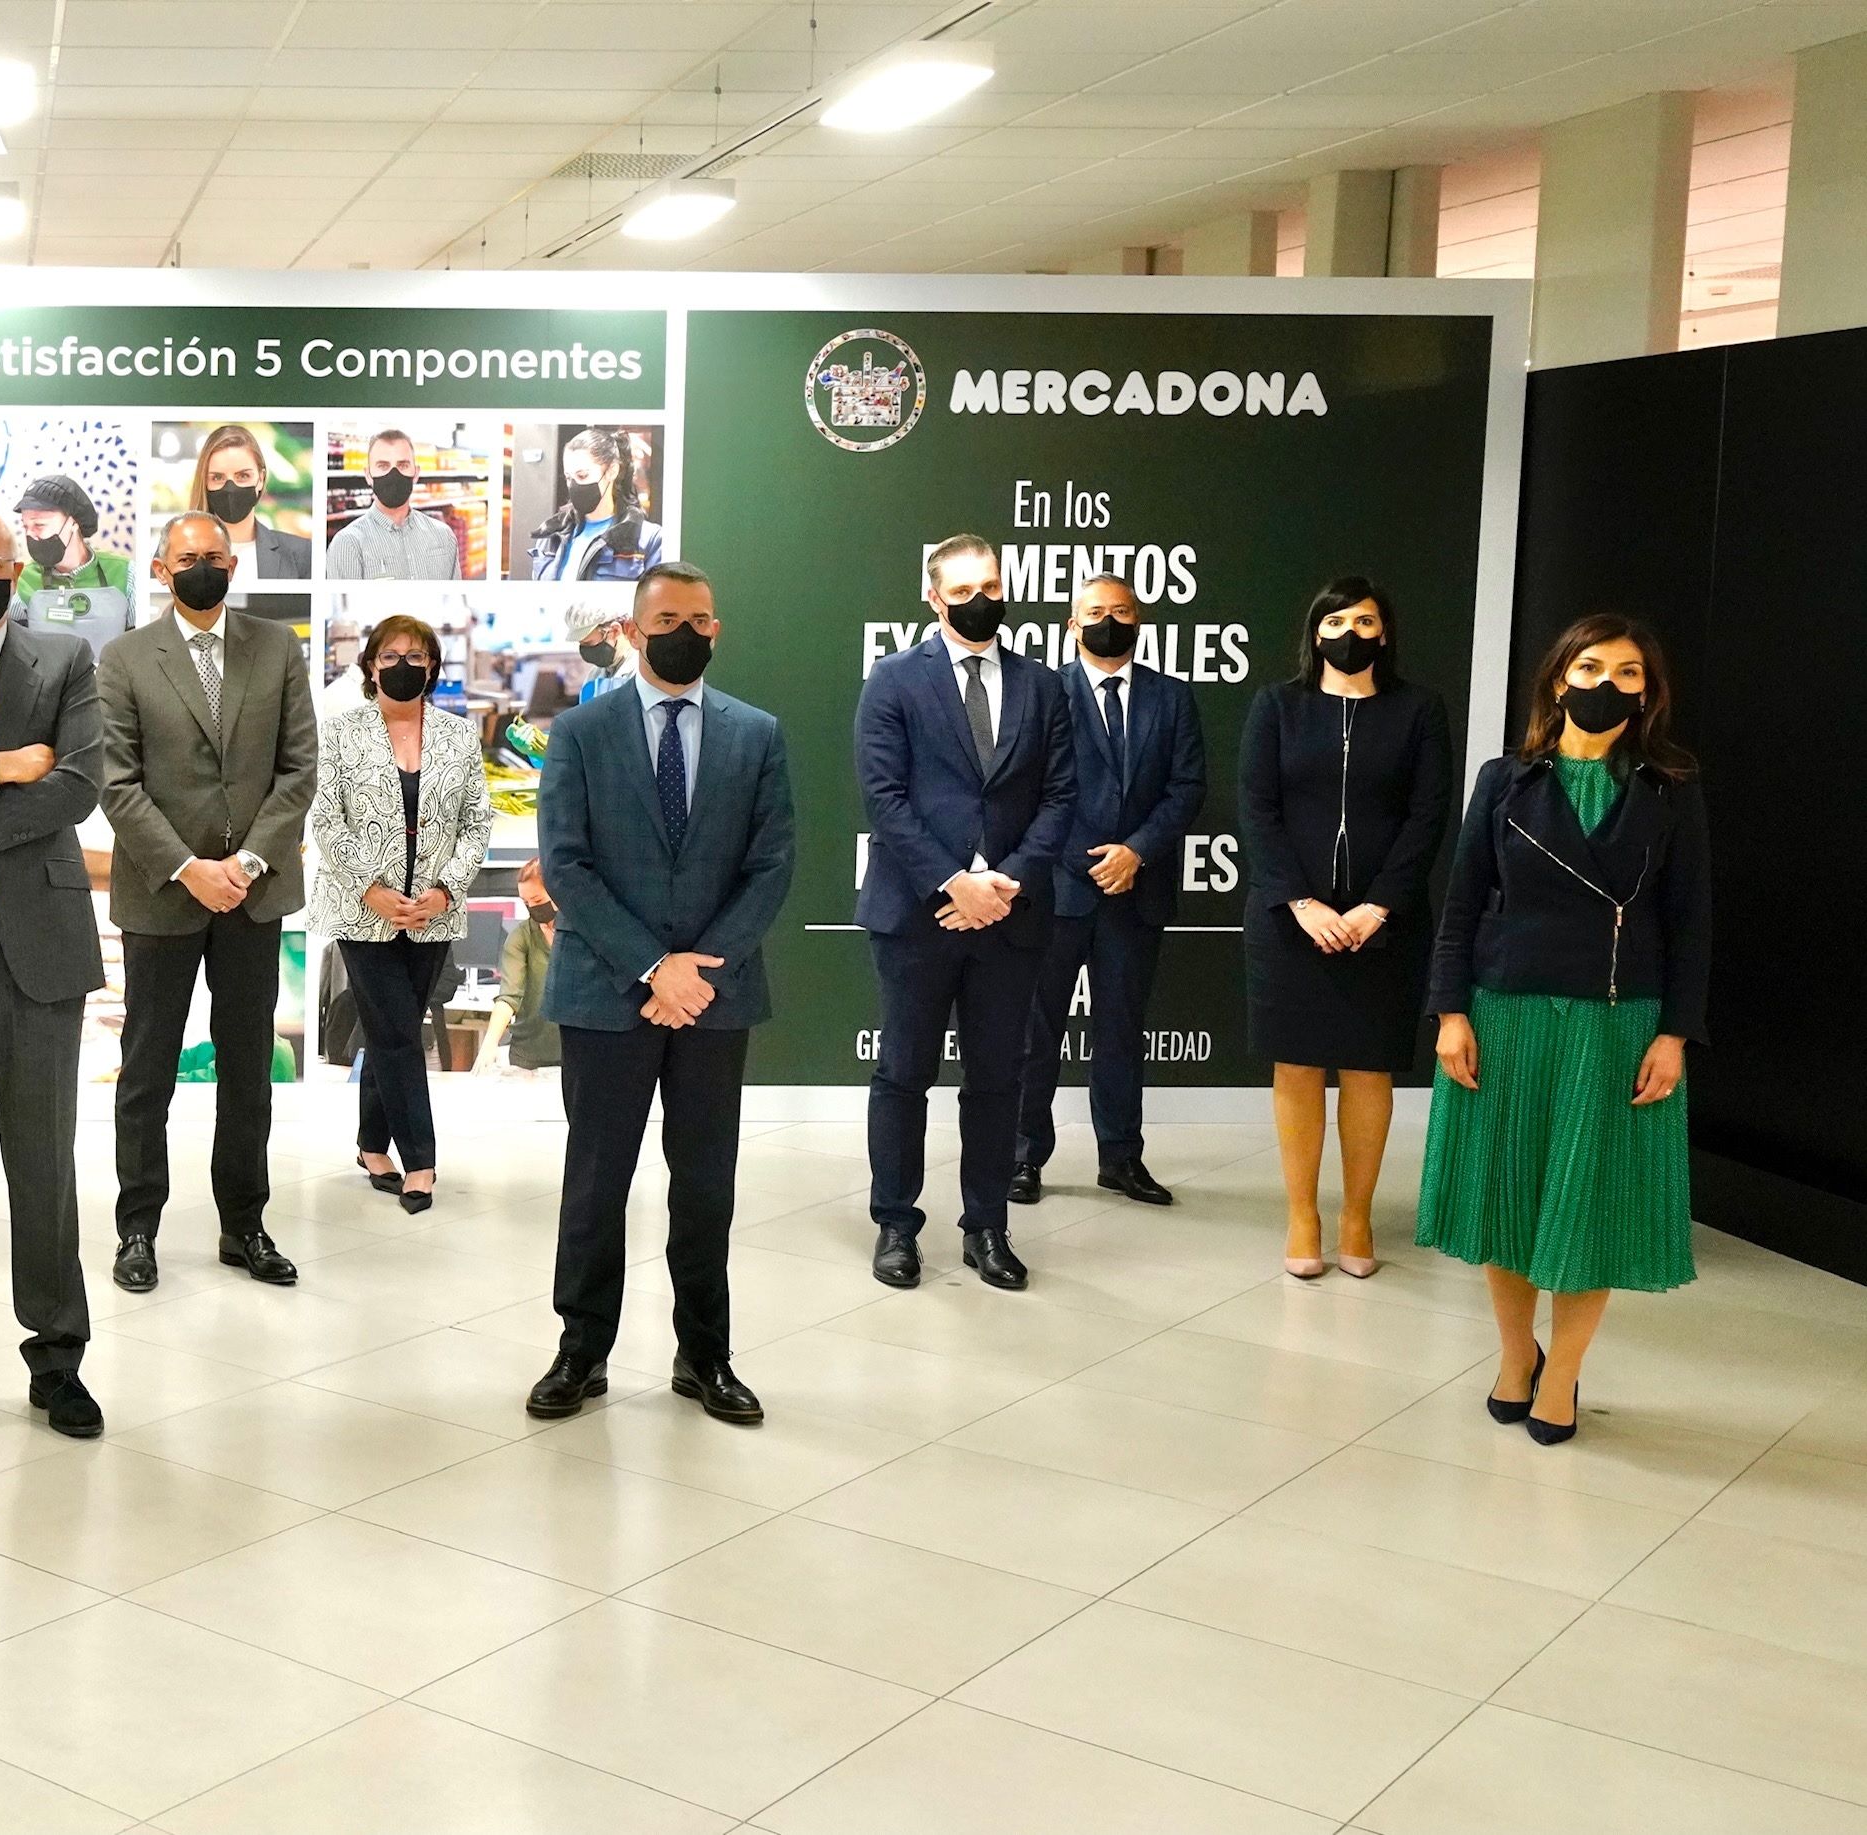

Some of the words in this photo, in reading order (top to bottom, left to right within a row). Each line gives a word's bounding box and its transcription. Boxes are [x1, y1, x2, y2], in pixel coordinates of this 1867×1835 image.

[255, 339, 282, 377] 5
[300, 339, 643, 386] Componentes
[949, 369, 1328, 417] MERCADONA
[1014, 480, 1051, 528] En
[1064, 480, 1111, 528] los
[921, 543, 1198, 604] MENTOS
